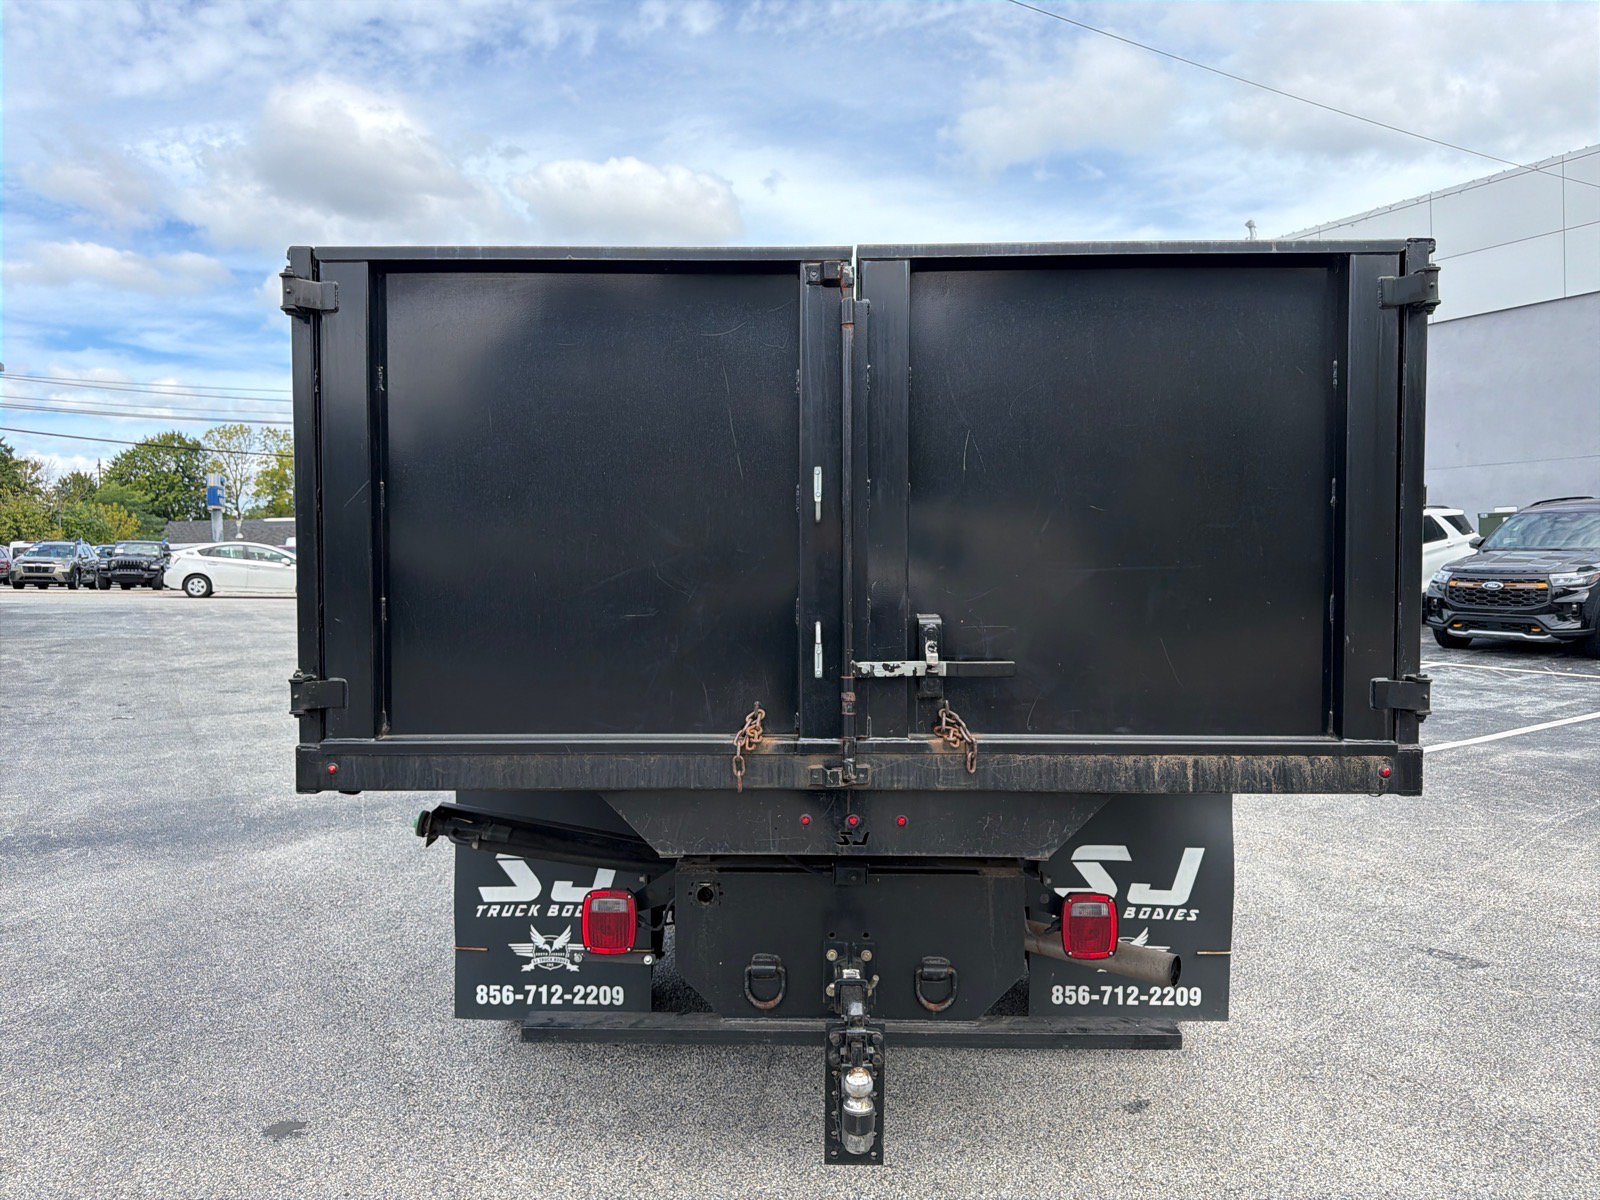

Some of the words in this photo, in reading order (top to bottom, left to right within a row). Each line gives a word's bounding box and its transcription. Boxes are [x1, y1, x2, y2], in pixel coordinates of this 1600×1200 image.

[835, 831, 870, 847] SJ
[1054, 844, 1206, 906] SJ
[475, 904, 541, 918] TRUCK
[546, 904, 583, 918] BOD
[1123, 906, 1200, 922] BODIES
[475, 984, 625, 1006] 856-712-2209
[1051, 985, 1202, 1007] 856-712-2209
